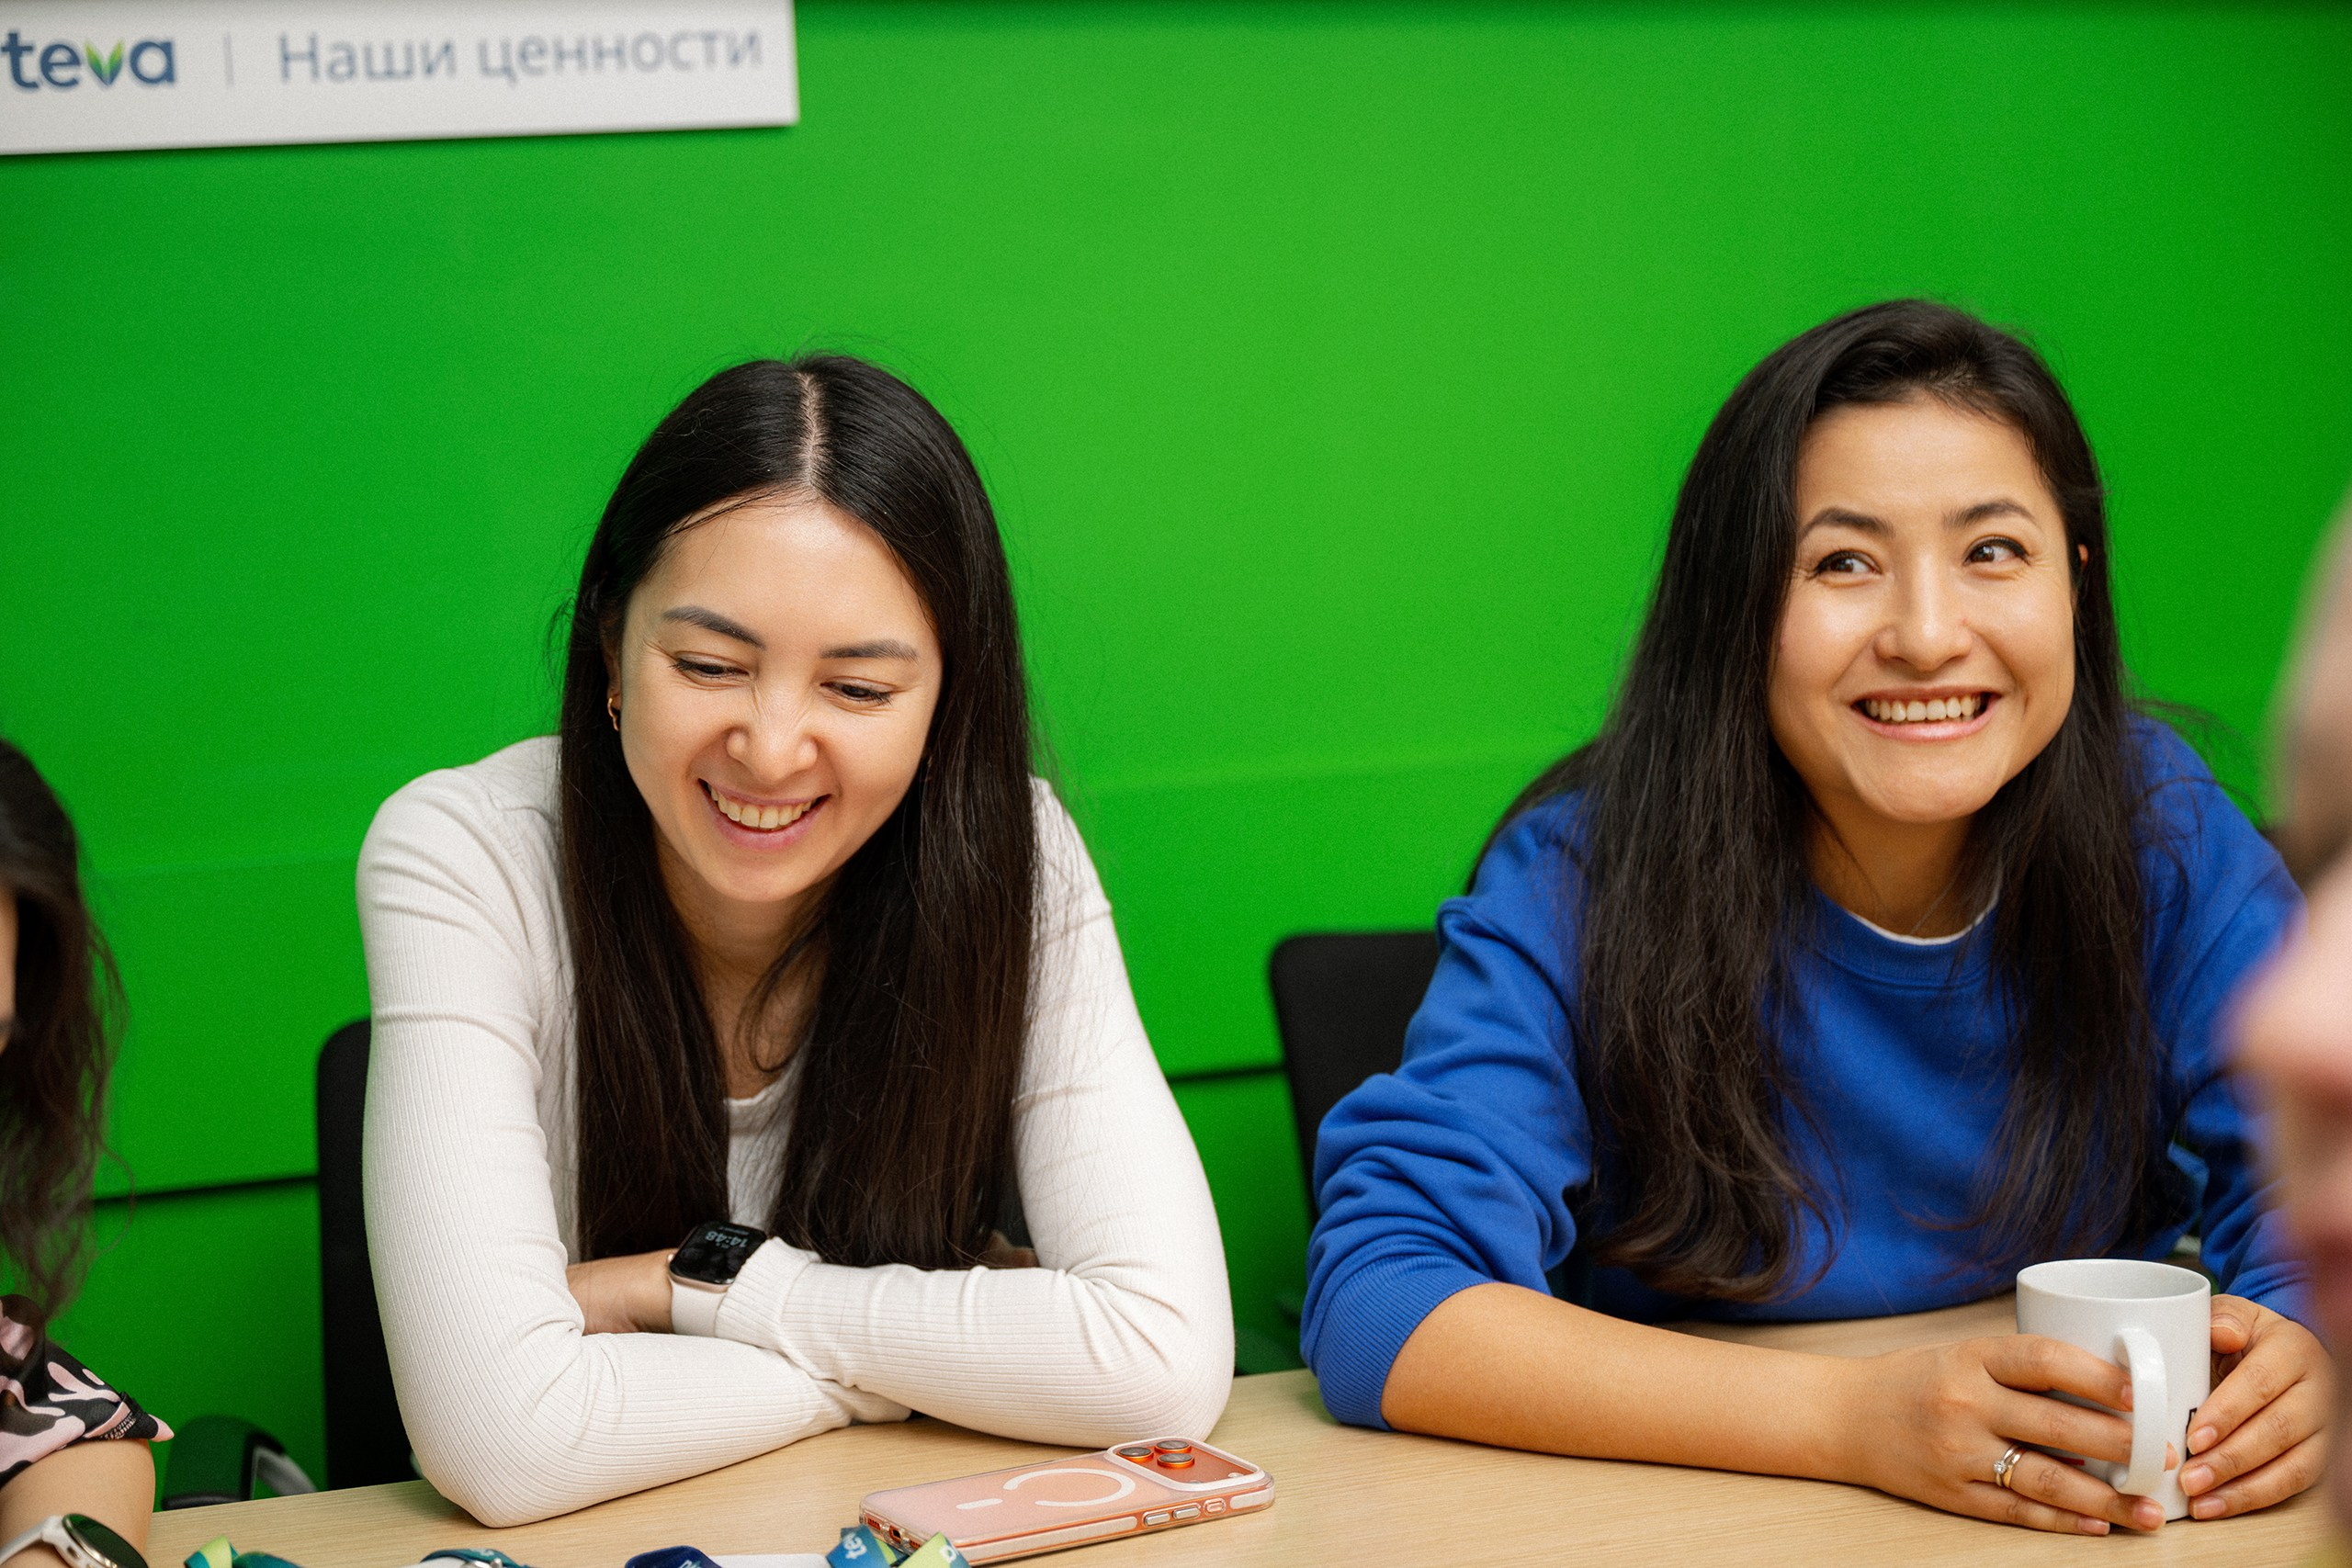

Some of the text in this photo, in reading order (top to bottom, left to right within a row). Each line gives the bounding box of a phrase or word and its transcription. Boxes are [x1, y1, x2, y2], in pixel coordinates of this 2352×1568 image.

[1, 32, 175, 88] teva
[277, 28, 764, 86] Наши ценности
